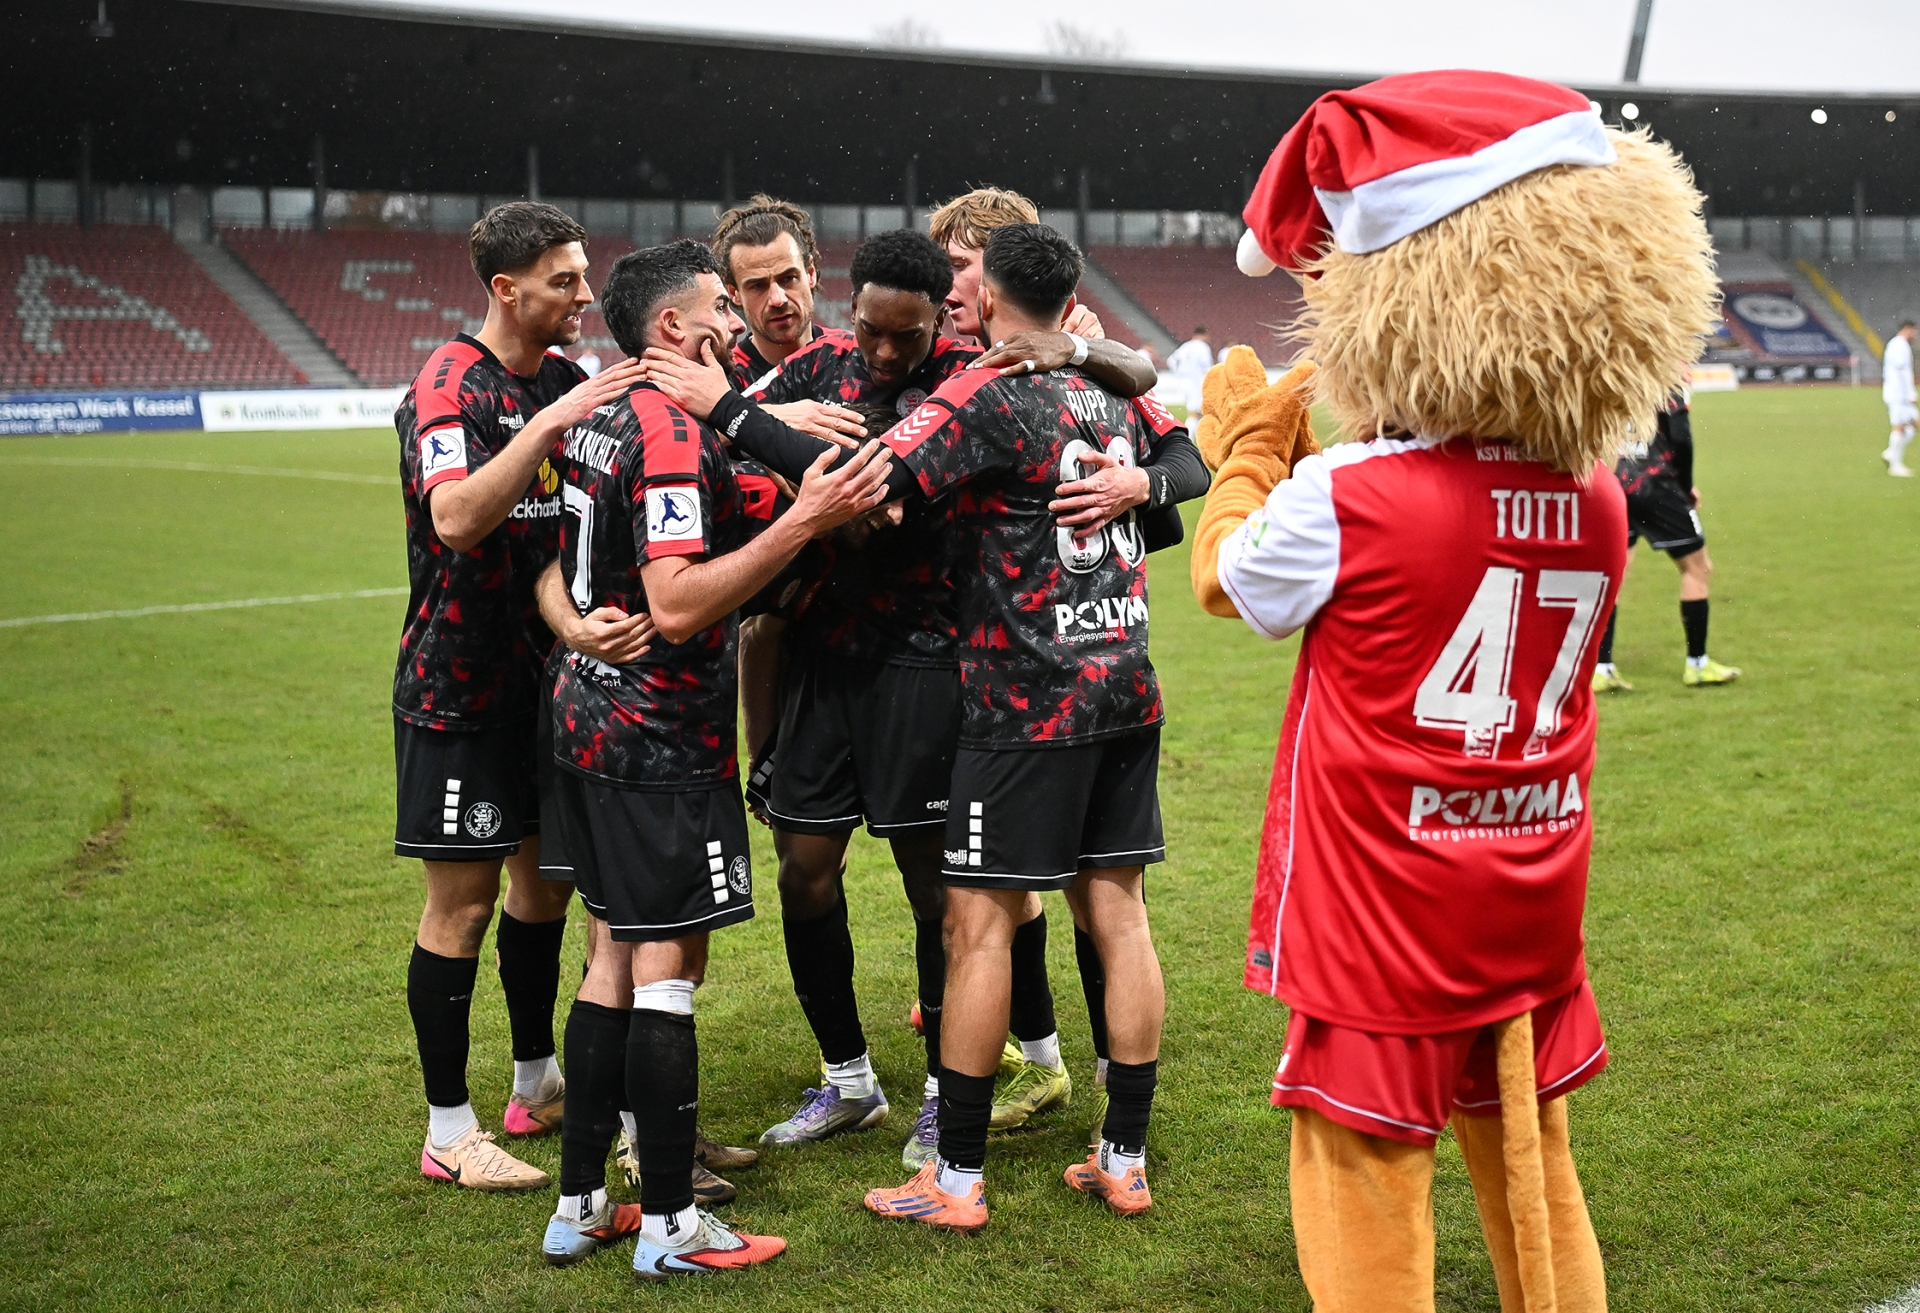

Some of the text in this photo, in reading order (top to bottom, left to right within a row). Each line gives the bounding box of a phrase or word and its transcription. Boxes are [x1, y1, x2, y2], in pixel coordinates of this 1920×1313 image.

[78, 396, 131, 418] Werk
[133, 395, 195, 417] Kassel
[1065, 389, 1108, 422] RUPP
[1475, 444, 1501, 462] KSV
[1490, 489, 1581, 541] TOTTI
[1413, 566, 1611, 762] 47
[1408, 772, 1584, 827] POLYMA
[1408, 824, 1545, 843] Energiesysteme
